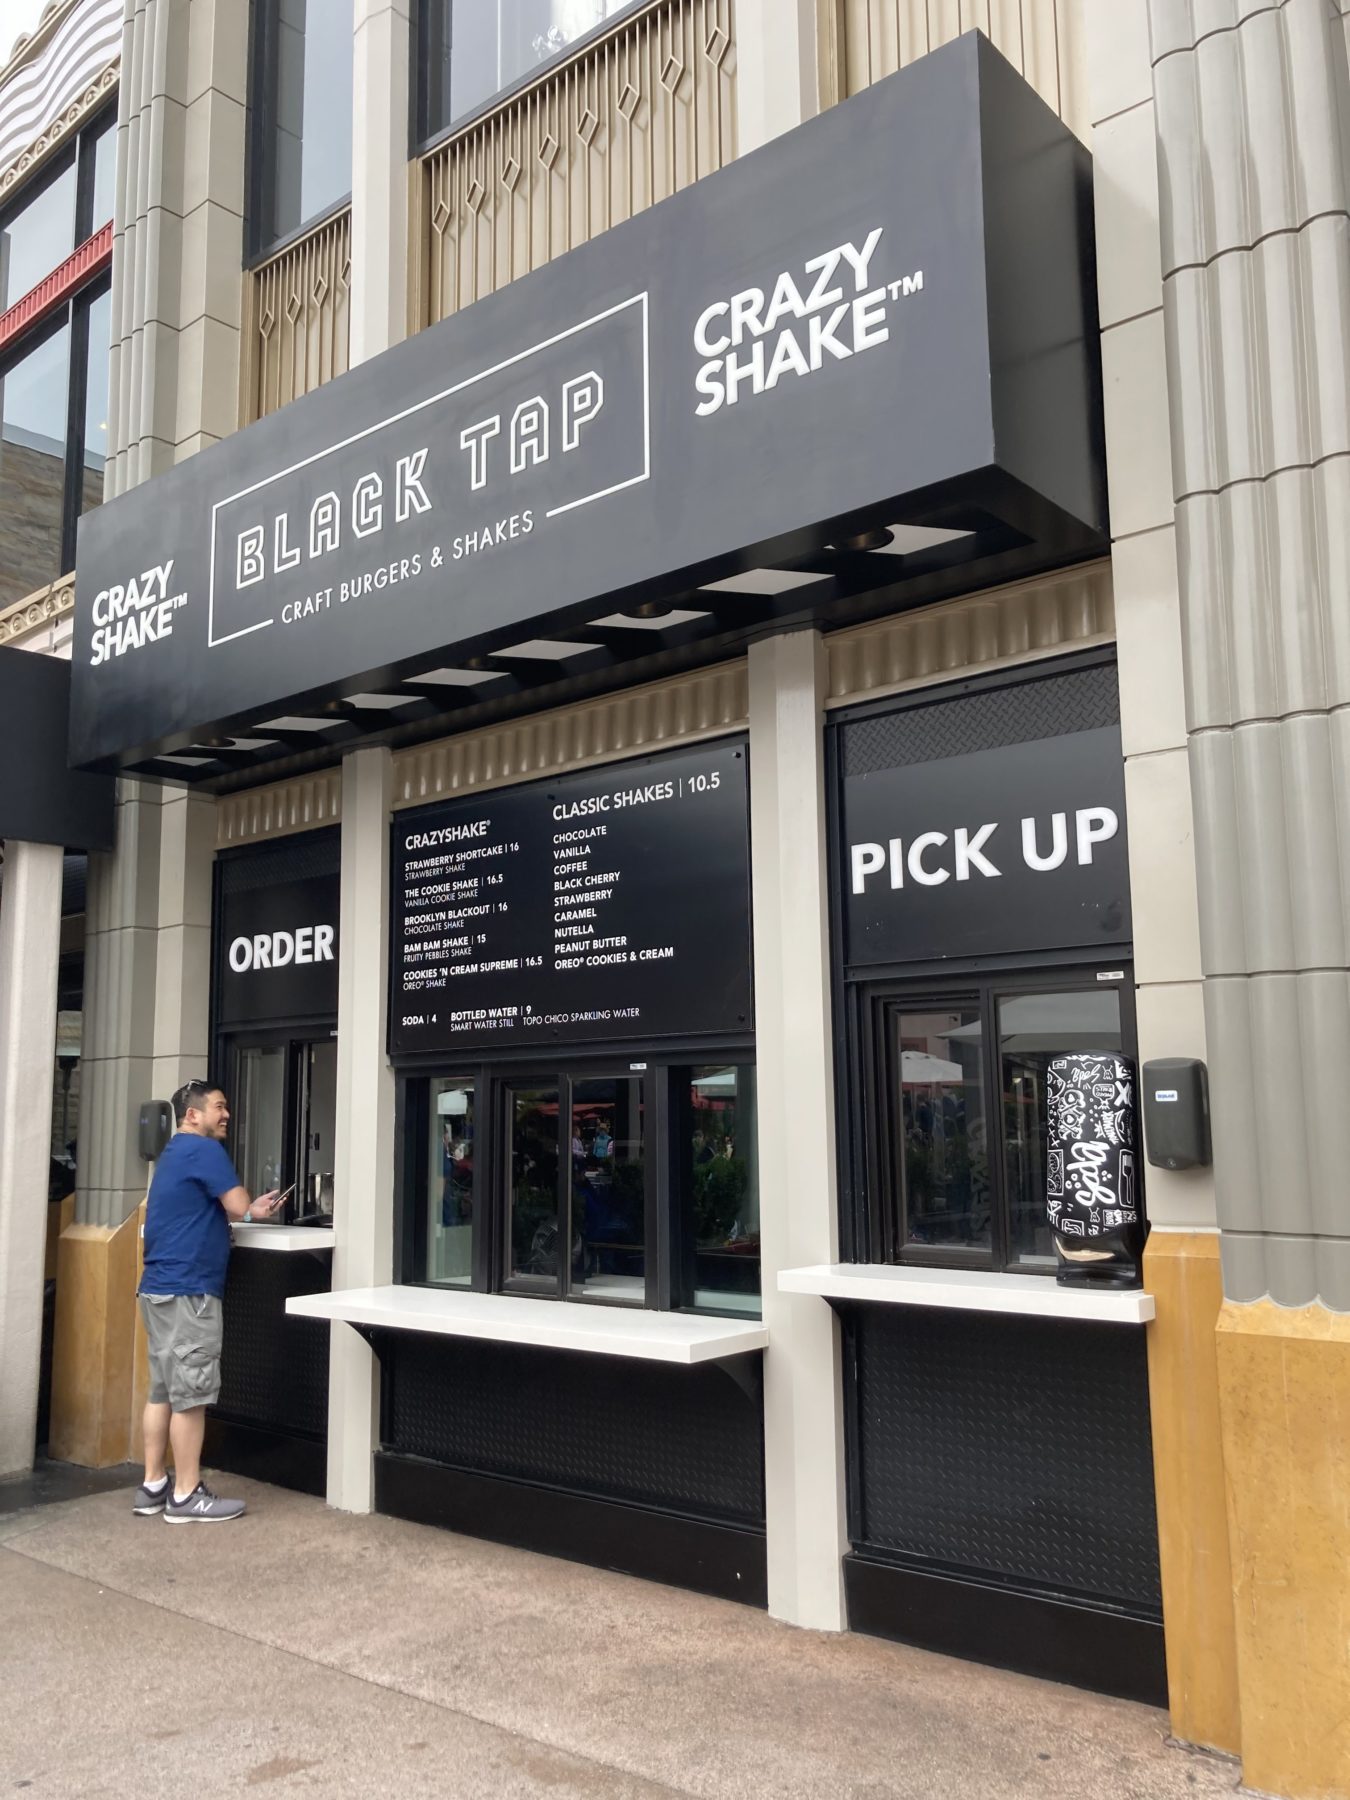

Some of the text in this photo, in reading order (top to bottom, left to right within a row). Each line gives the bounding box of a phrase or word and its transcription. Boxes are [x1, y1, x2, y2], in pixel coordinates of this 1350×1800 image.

[694, 227, 883, 357] CRAZY
[235, 370, 604, 589] BLACK TAP
[281, 510, 534, 623] CRAFT BURGERS & SHAKES
[92, 559, 174, 626] CRAZY
[553, 772, 720, 820] CLASSIC SHAKES 10.5
[554, 826, 606, 844] CHOCOLATE
[406, 842, 519, 871] STRAWBERRY SHORTCAKE 16
[554, 845, 590, 859] VANILLA
[851, 806, 1119, 895] PICK UP
[405, 863, 465, 880] STRAWBERRY SHAKE
[554, 861, 587, 874] COFFEE
[405, 874, 503, 898] THE COOKIE SHAKE 16.5
[554, 872, 620, 890] BLACK CHERRY
[405, 889, 478, 907] VANILLA COOKIE SHAKE
[554, 889, 612, 906] STRAWBERRY
[405, 902, 507, 925] BROOKLYN BLACKOUT 16
[555, 908, 596, 922] CARAMEL
[404, 920, 464, 935] CHOCOLATE SHAKE
[555, 924, 594, 938] NUTELLA
[229, 924, 335, 973] ORDER
[404, 934, 486, 953] BAM BAM SHAKE 15
[555, 936, 626, 953] PEANUT BUTTER
[404, 947, 471, 962] FRUITY PEBBLES SHAKE
[586, 953, 627, 966] COOKIES
[629, 951, 637, 962] &
[640, 947, 673, 960] CREAM
[404, 969, 437, 980] COOKIES
[450, 964, 478, 975] CREAM
[480, 959, 518, 972] SUPREME
[526, 956, 542, 966] 16.5
[426, 978, 446, 988] SHAKE
[403, 1013, 437, 1025] SODA 4
[451, 1005, 532, 1021] BOTTLED WATER 9
[523, 1016, 542, 1025] TOPO
[545, 1008, 639, 1024] CHICO SPARKLING WATER
[451, 1019, 514, 1031] SMART WATER STILL
